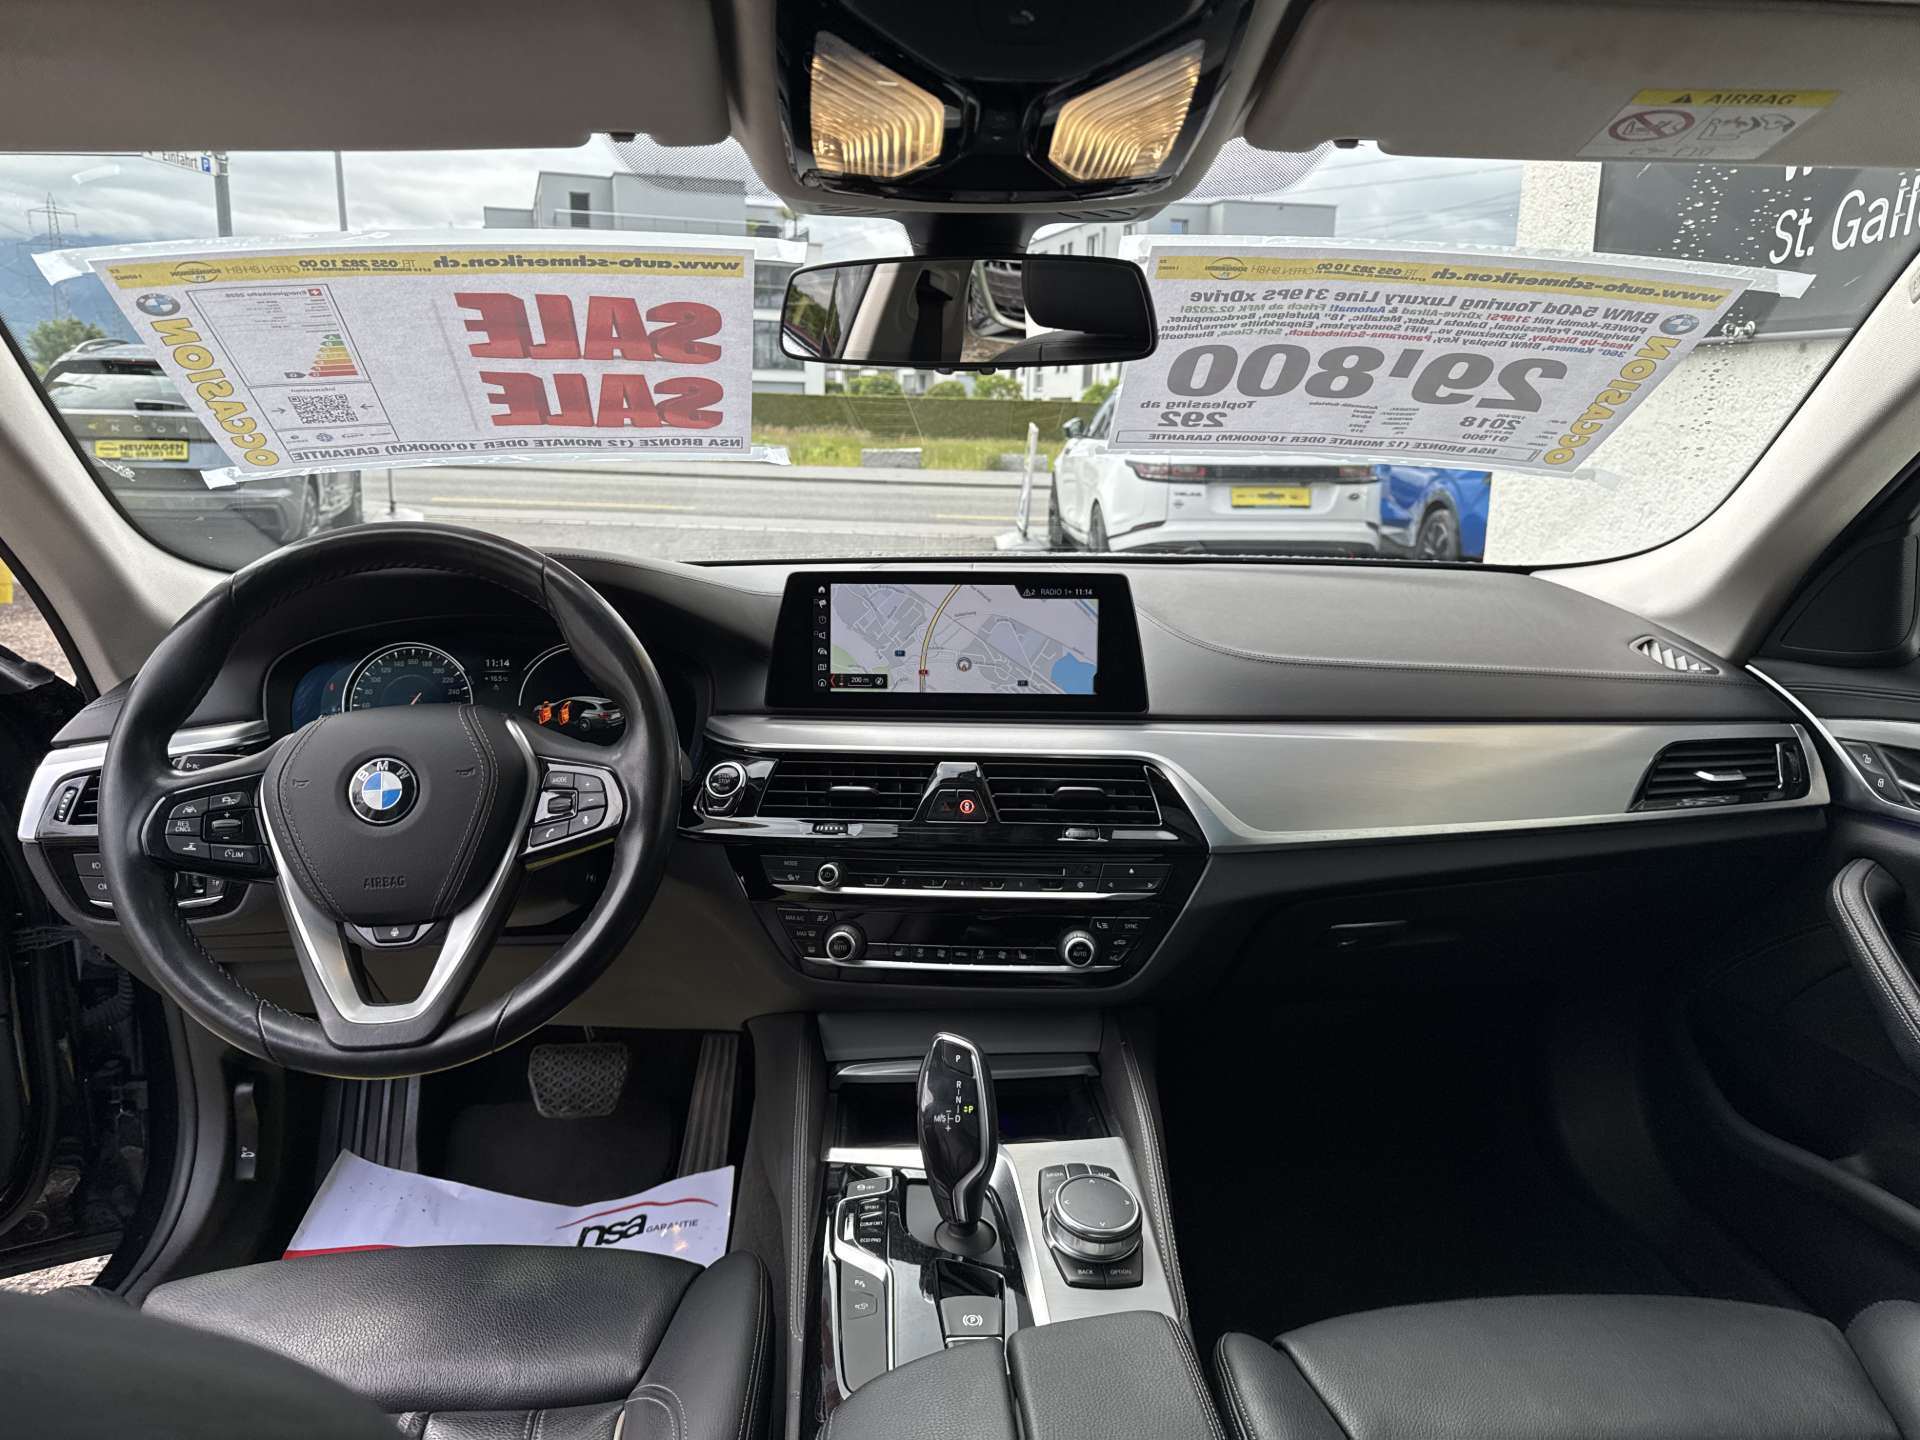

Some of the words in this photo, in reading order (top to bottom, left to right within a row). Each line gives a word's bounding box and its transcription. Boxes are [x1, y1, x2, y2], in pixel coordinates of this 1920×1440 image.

[1703, 93, 1798, 105] AIRBAG
[162, 151, 198, 169] Einfahrt
[1769, 208, 1815, 264] St.
[1831, 176, 1920, 250] Gall
[1040, 588, 1062, 596] RADIO
[1075, 588, 1093, 596] 11:14
[485, 658, 511, 668] 11:14
[363, 876, 407, 888] AIRBAG
[1072, 950, 1087, 958] AUTO
[577, 1214, 647, 1248] nsa
[646, 1218, 699, 1233] GARANTIE
